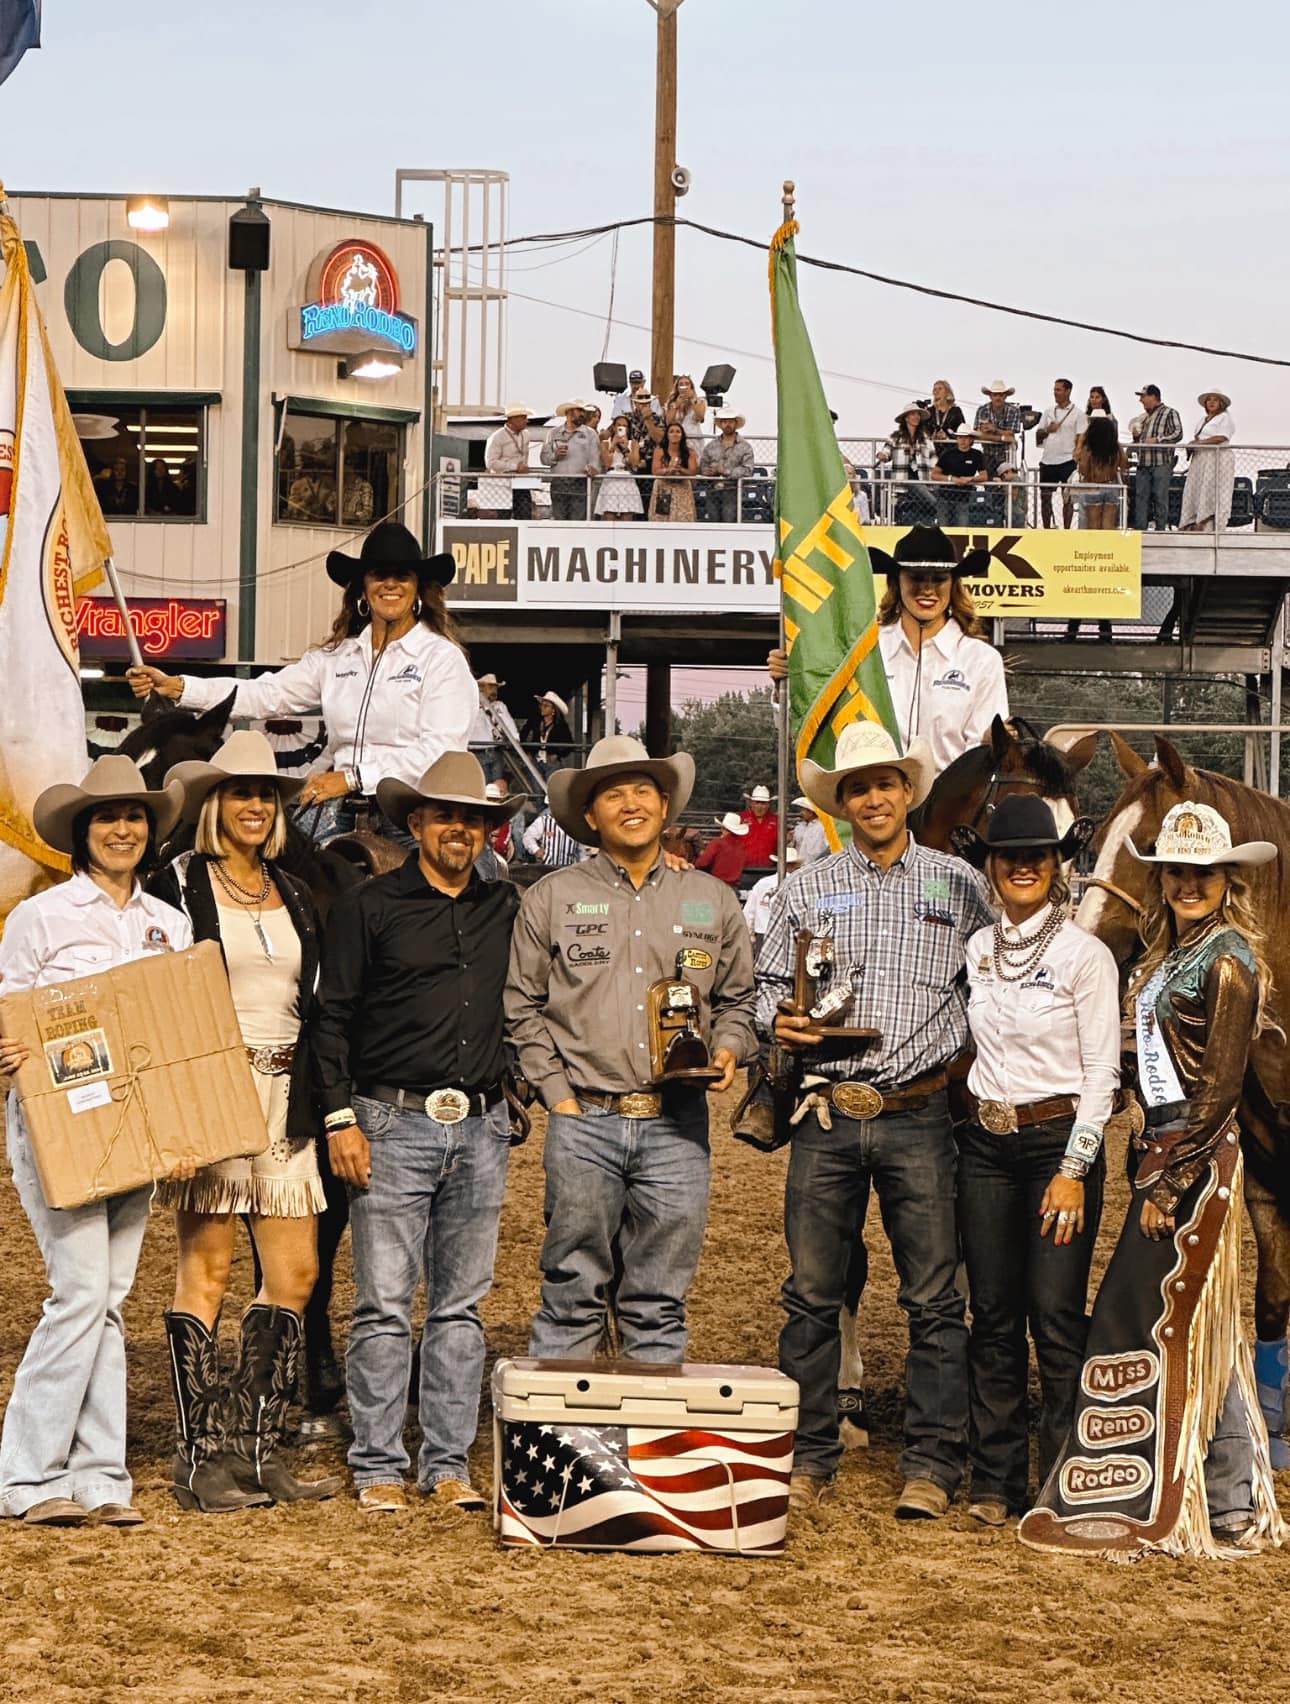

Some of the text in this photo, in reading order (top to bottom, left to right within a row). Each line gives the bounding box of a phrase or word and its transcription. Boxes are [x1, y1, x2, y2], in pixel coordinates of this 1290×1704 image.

[303, 301, 415, 350] RENO RODEO
[527, 546, 776, 585] MACHINERY
[1053, 563, 1096, 573] opportunities
[1074, 551, 1114, 561] Employment
[576, 902, 609, 915] Smarty
[47, 1001, 87, 1022] TEAM
[45, 1015, 98, 1040] ROPING
[1144, 1051, 1168, 1104] Rodeo
[1093, 1364, 1146, 1388] Miss
[1089, 1417, 1141, 1437] Reno
[1071, 1466, 1138, 1490] Rodeo
